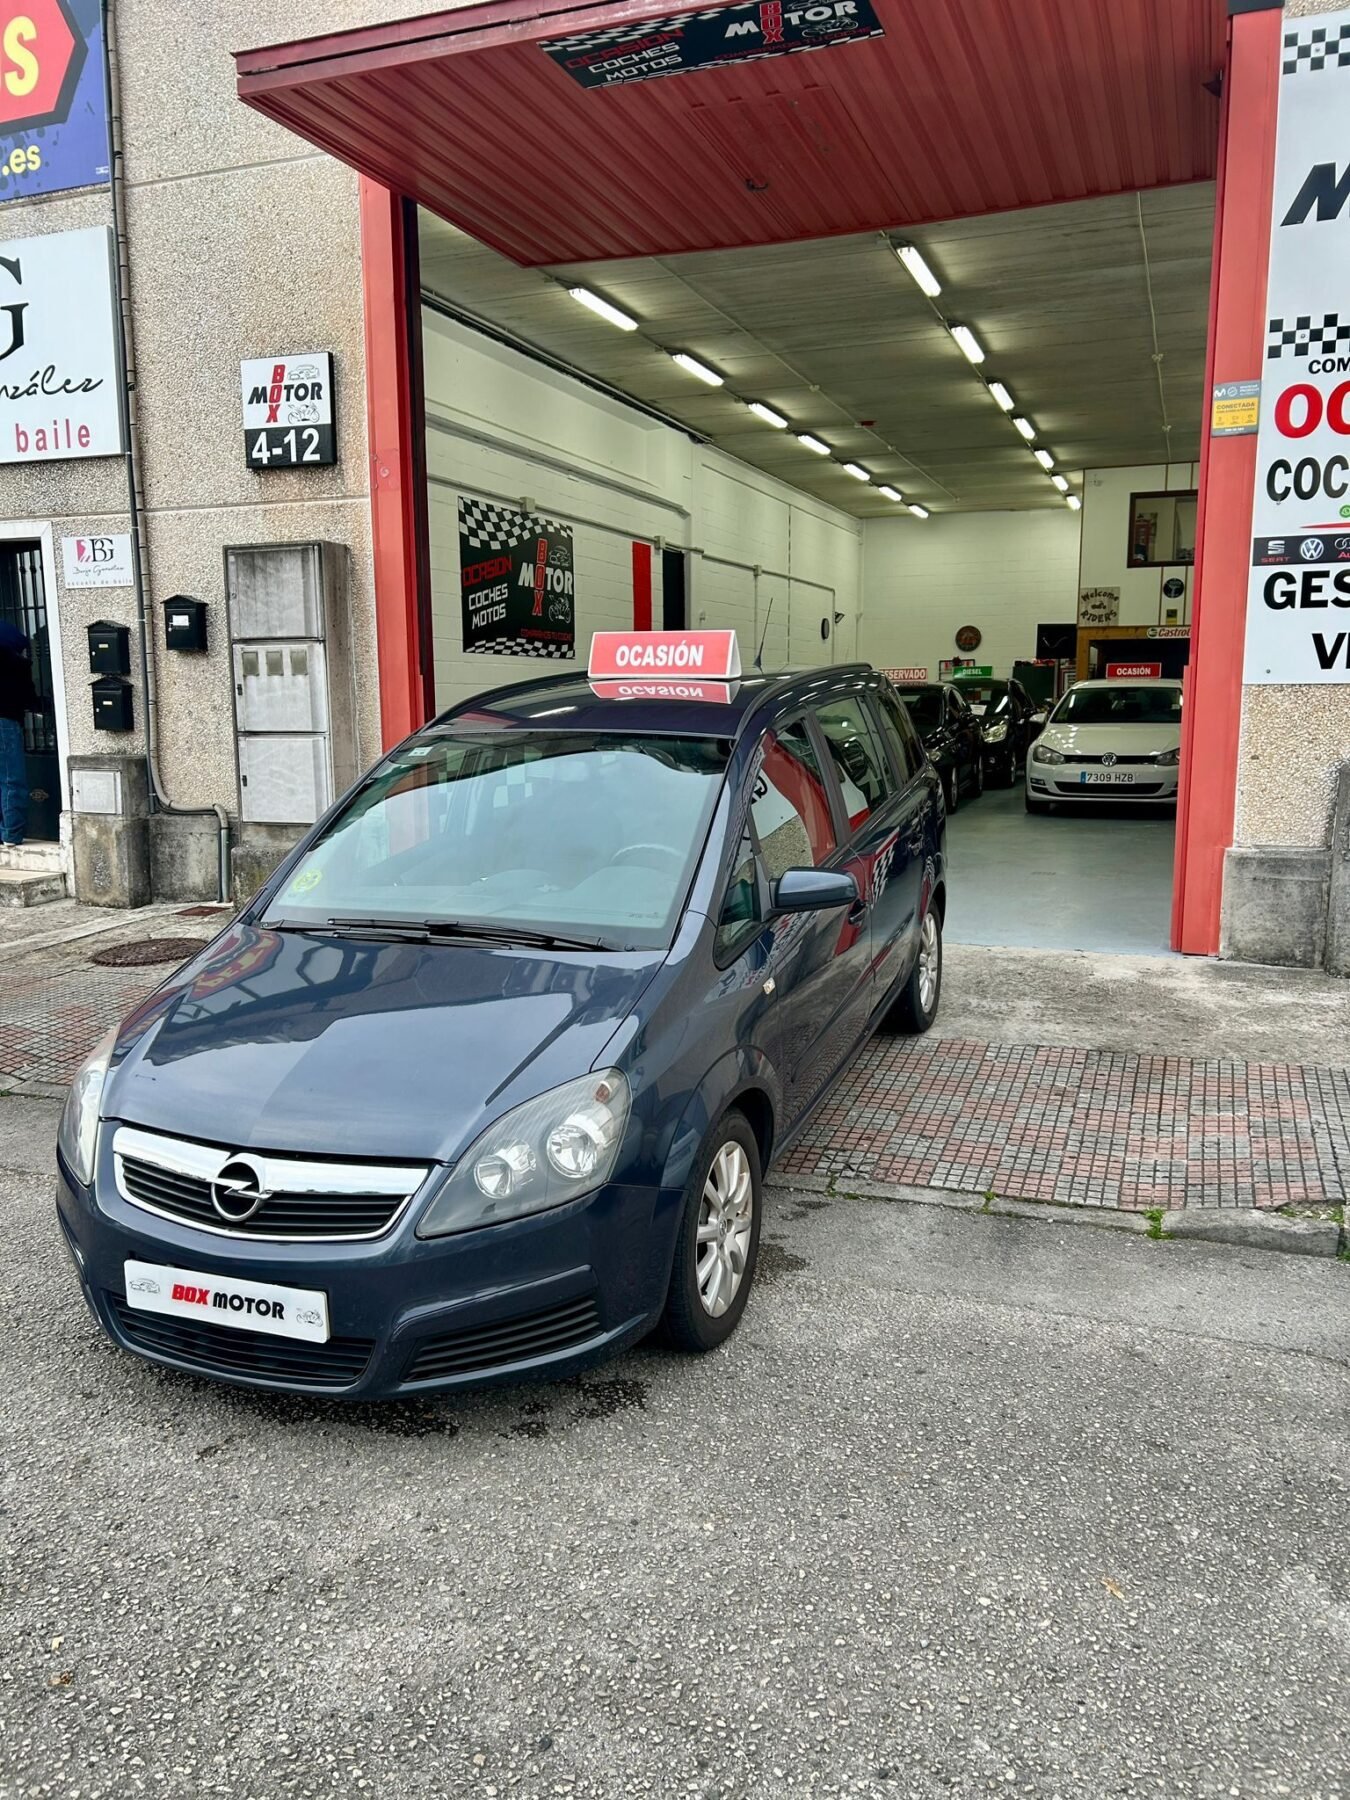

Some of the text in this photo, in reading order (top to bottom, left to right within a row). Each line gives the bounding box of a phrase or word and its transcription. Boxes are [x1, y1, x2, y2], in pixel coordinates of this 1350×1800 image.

[564, 27, 686, 69] OCASION
[588, 41, 681, 74] COCHES
[605, 55, 683, 81] MOTOS
[248, 382, 323, 405] MOTOR
[266, 364, 286, 423] BOX
[15, 418, 91, 453] baile
[251, 427, 321, 465] 4-12
[462, 555, 512, 586] OCASION
[468, 583, 508, 610] COCHES
[1081, 588, 1119, 602] Welcome
[472, 603, 507, 629] MOTOS
[1080, 609, 1117, 623] RIDERS
[615, 640, 704, 667] OCASIÓN
[1116, 666, 1152, 676] OCASIÓN
[1087, 773, 1112, 783] 7309
[172, 1284, 285, 1320] BOX MOTOR
